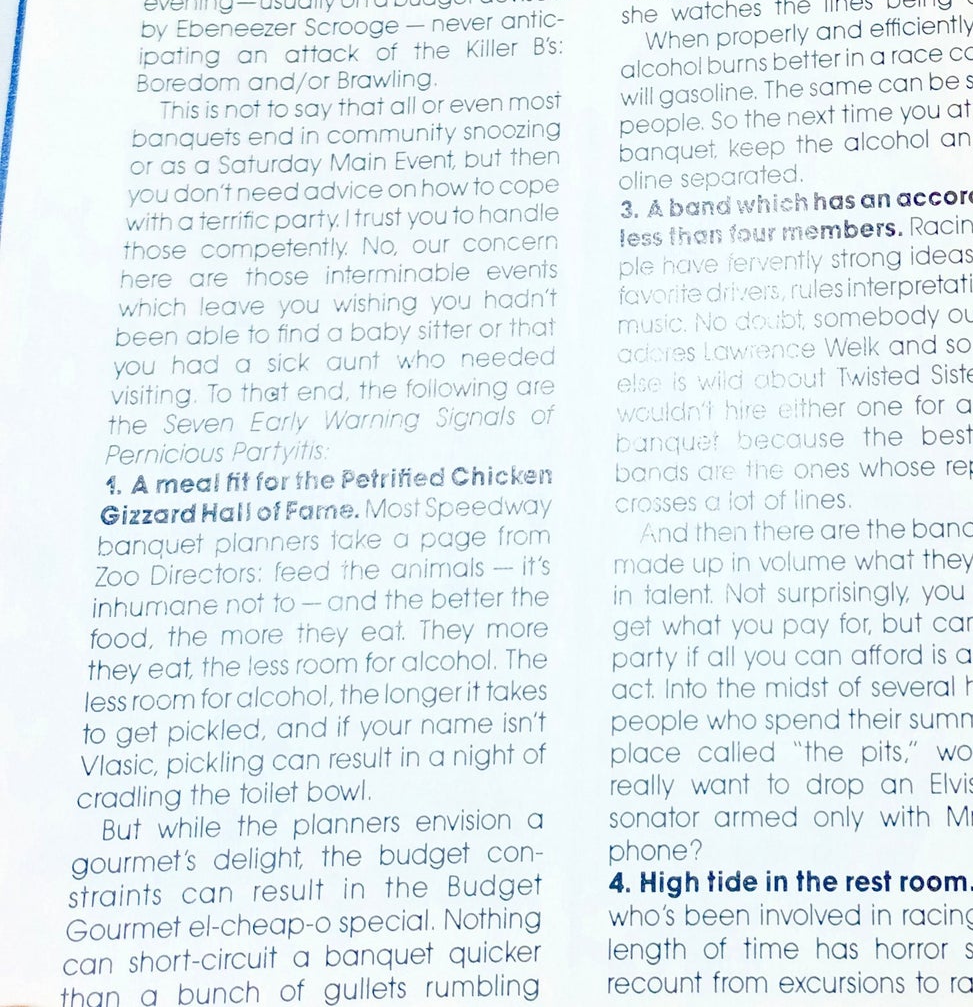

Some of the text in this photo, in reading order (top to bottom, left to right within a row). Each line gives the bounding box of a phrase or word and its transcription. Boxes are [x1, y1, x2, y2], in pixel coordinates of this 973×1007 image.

[137, 69, 437, 94] Boredom and/or Brawling.
[130, 147, 560, 177] or as a Saturday Main Event, but then
[123, 235, 558, 262] those competently. No, our concern
[77, 779, 371, 812] cradling the toilet bowl.
[102, 809, 543, 841] But while the planners envision a
[609, 806, 700, 829] sonator
[714, 806, 797, 828] armed
[814, 805, 864, 832] only
[880, 805, 930, 827] with
[72, 842, 543, 881] gourmet's delight, the budget con-
[609, 872, 630, 893] 4.
[641, 871, 699, 898] High
[707, 870, 758, 892] tide
[766, 870, 788, 892] in
[796, 870, 838, 892] the
[846, 870, 892, 892] rest
[608, 937, 686, 966] length
[703, 937, 727, 960] of
[743, 937, 799, 960] time
[816, 937, 858, 960] has
[875, 937, 948, 960] horror
